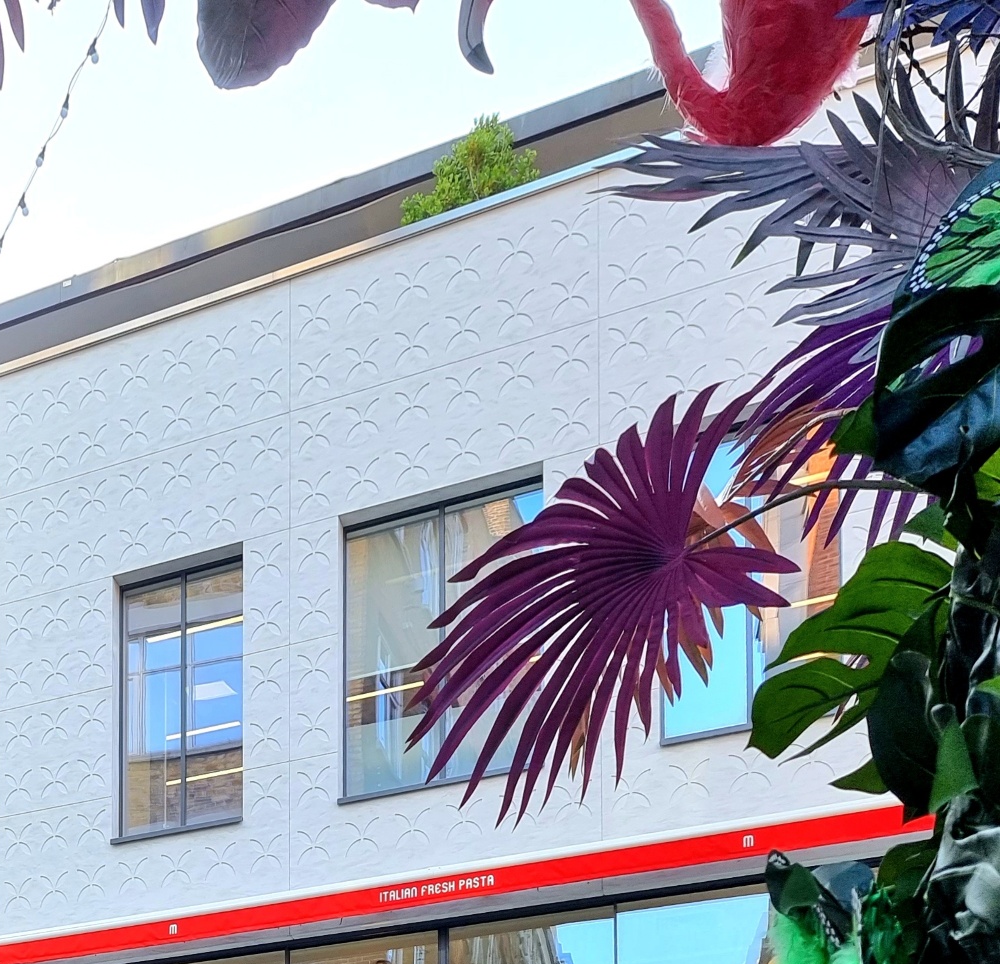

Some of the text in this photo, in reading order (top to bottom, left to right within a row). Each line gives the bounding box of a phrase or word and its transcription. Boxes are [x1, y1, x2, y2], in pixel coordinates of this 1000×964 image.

[379, 874, 495, 903] ITALIAN FRESH PASTA
